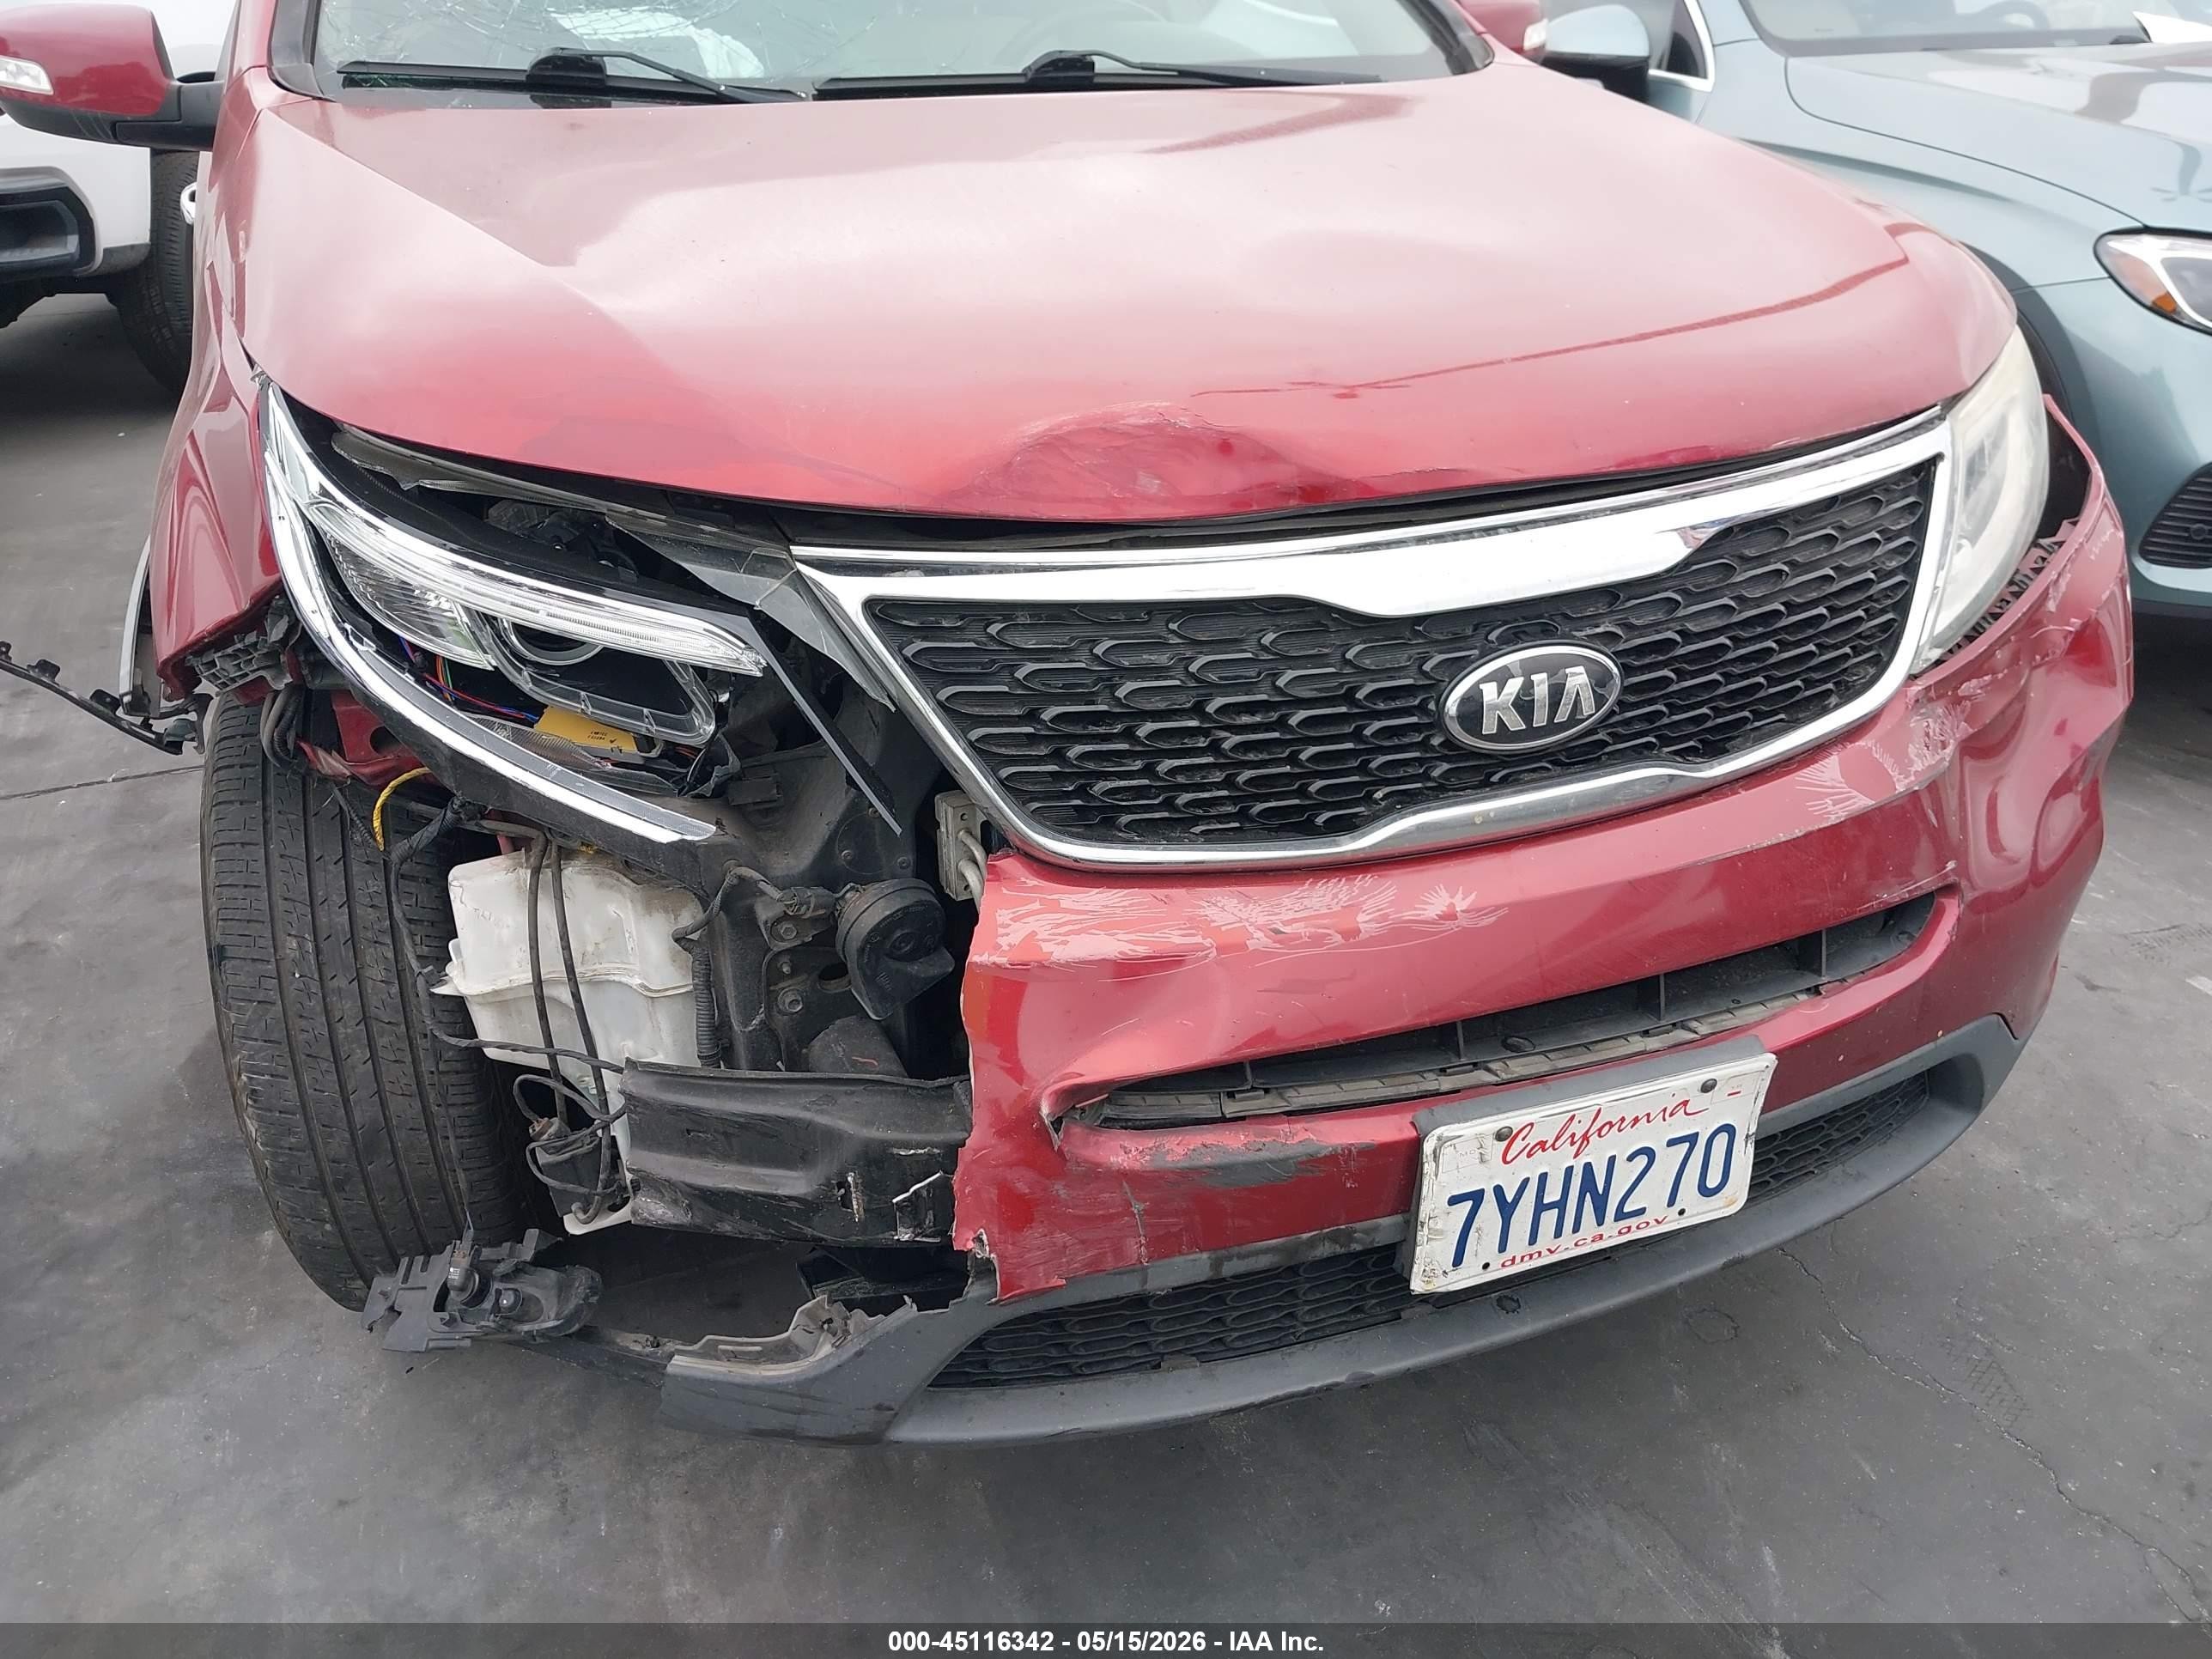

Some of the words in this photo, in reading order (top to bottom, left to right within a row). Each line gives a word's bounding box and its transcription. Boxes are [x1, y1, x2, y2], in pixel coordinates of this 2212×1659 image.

[1480, 665, 1595, 734] KIA
[1501, 1094, 1708, 1165] California
[1447, 1122, 1736, 1268] 7YHN270
[1501, 1215, 1668, 1269] dmv.ca.gov
